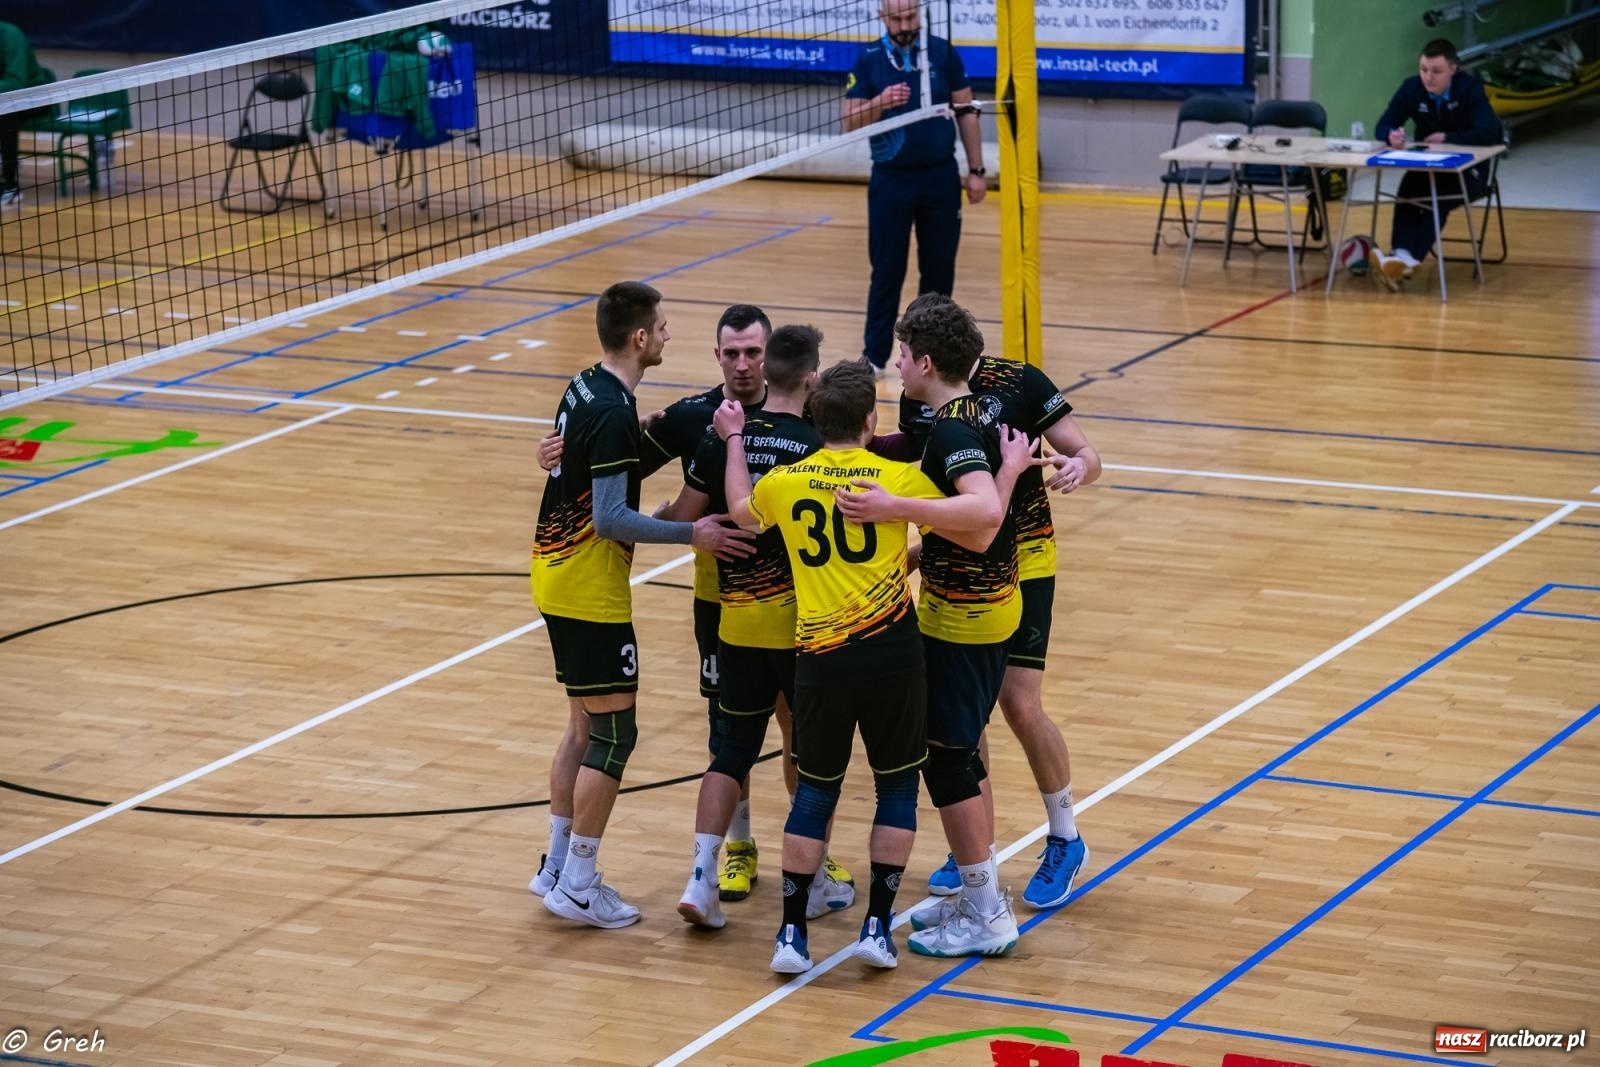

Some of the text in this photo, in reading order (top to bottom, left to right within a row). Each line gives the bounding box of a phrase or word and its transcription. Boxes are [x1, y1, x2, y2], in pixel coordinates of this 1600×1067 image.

[1095, 18, 1121, 29] von
[1211, 18, 1220, 31] 2
[1036, 56, 1158, 76] w.instal-tech.pl
[753, 435, 808, 455] SFERAWENT
[786, 464, 882, 479] TALENT SFERAWENT
[791, 498, 877, 568] 30
[620, 643, 637, 677] 3
[702, 654, 720, 685] 4
